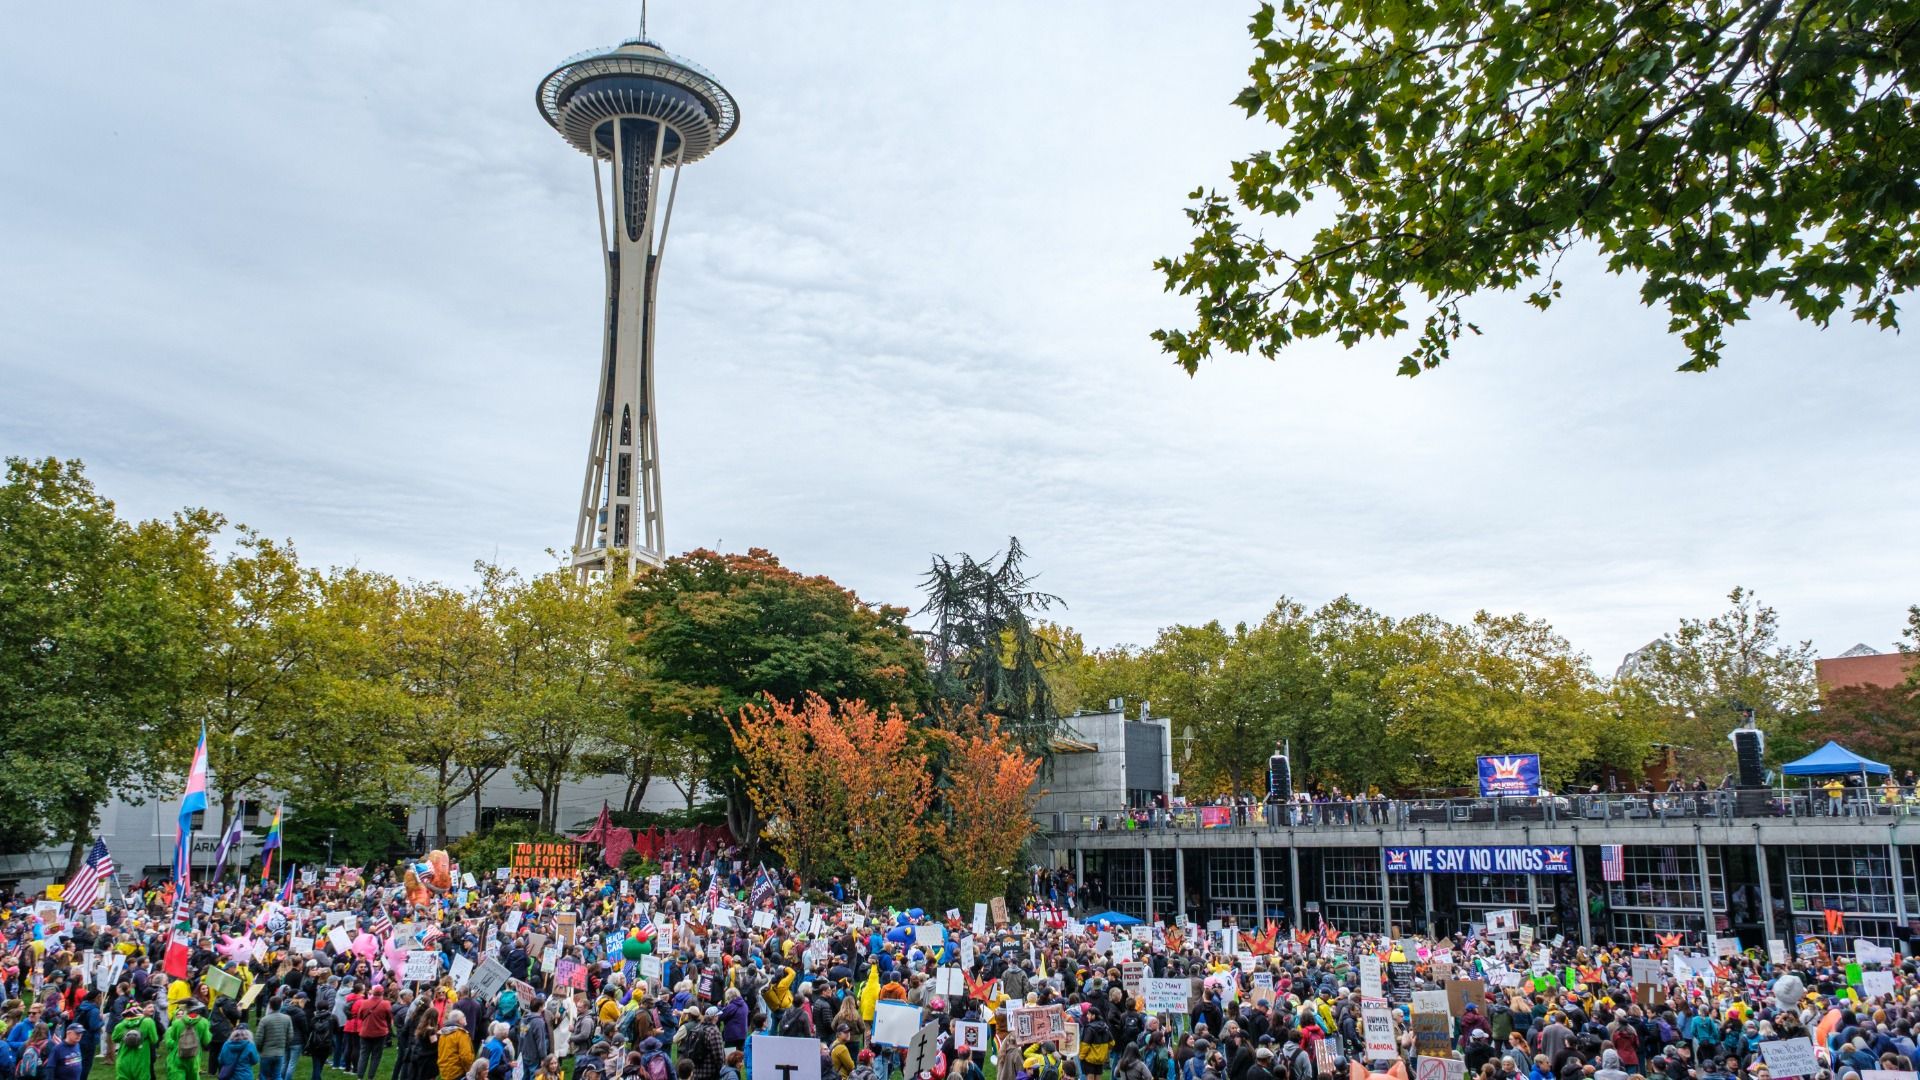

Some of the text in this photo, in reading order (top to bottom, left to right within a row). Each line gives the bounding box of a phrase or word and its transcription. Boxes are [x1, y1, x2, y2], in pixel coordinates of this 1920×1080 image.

[193, 843, 245, 852] ARMRY
[517, 843, 576, 855] NO KINGS!
[515, 855, 576, 867] NO FOOLS!
[1409, 849, 1542, 870] WE SAY NO KINGS
[512, 867, 545, 878] FIGHT
[606, 931, 625, 945] HEALTH
[607, 940, 624, 953] CARE
[1152, 982, 1163, 990] SO
[1367, 1016, 1388, 1024] HUMAN
